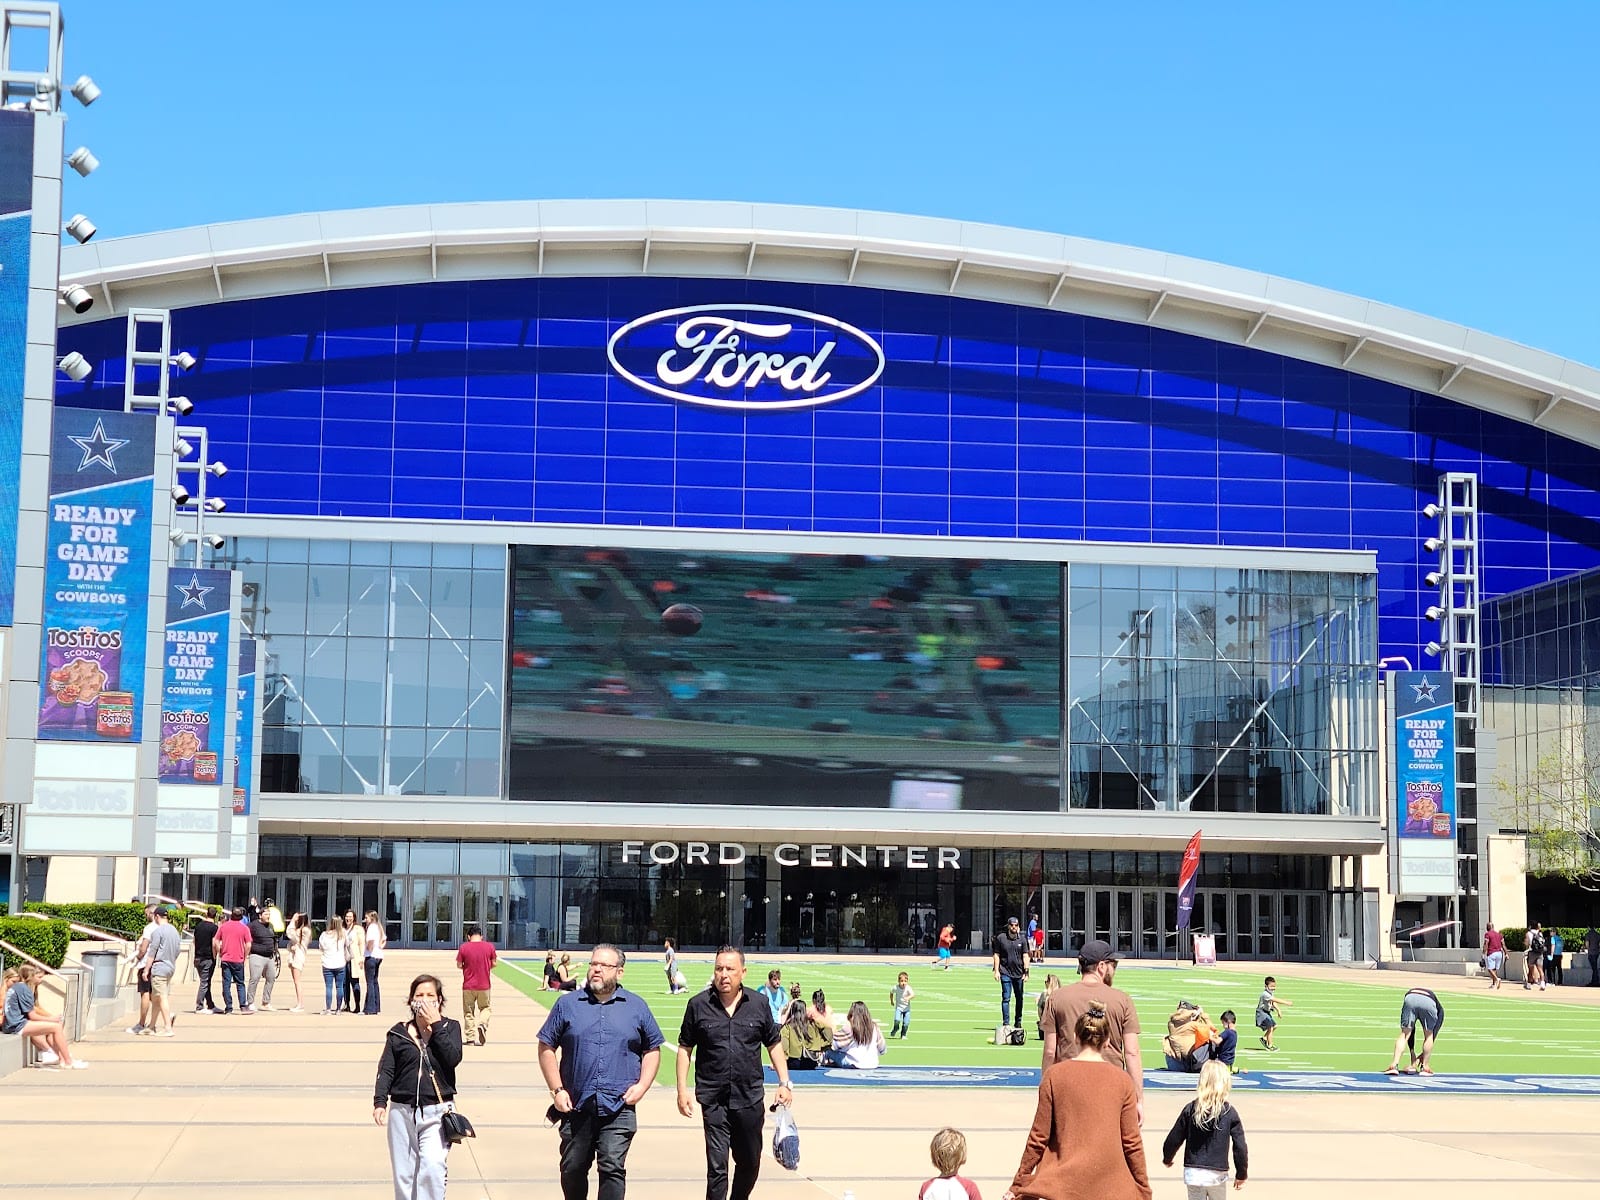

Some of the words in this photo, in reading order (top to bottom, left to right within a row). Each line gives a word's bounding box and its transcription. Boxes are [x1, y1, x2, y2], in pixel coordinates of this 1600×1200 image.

[656, 316, 837, 391] Ford
[54, 504, 136, 526] READY
[70, 524, 118, 543] FOR
[57, 544, 129, 564] GAME
[68, 563, 117, 582] DAY
[55, 590, 127, 604] COWBOYS
[166, 630, 219, 644] READY
[176, 643, 207, 655] FOR
[168, 655, 214, 668] GAME
[175, 668, 206, 680] DAY
[167, 686, 213, 695] COWBOYS
[1405, 719, 1446, 730] READY
[1413, 729, 1438, 739] FOR
[1408, 739, 1444, 749] GAME
[1413, 748, 1438, 759] DAY
[621, 840, 747, 864] FORD
[773, 842, 961, 869] CENTER
